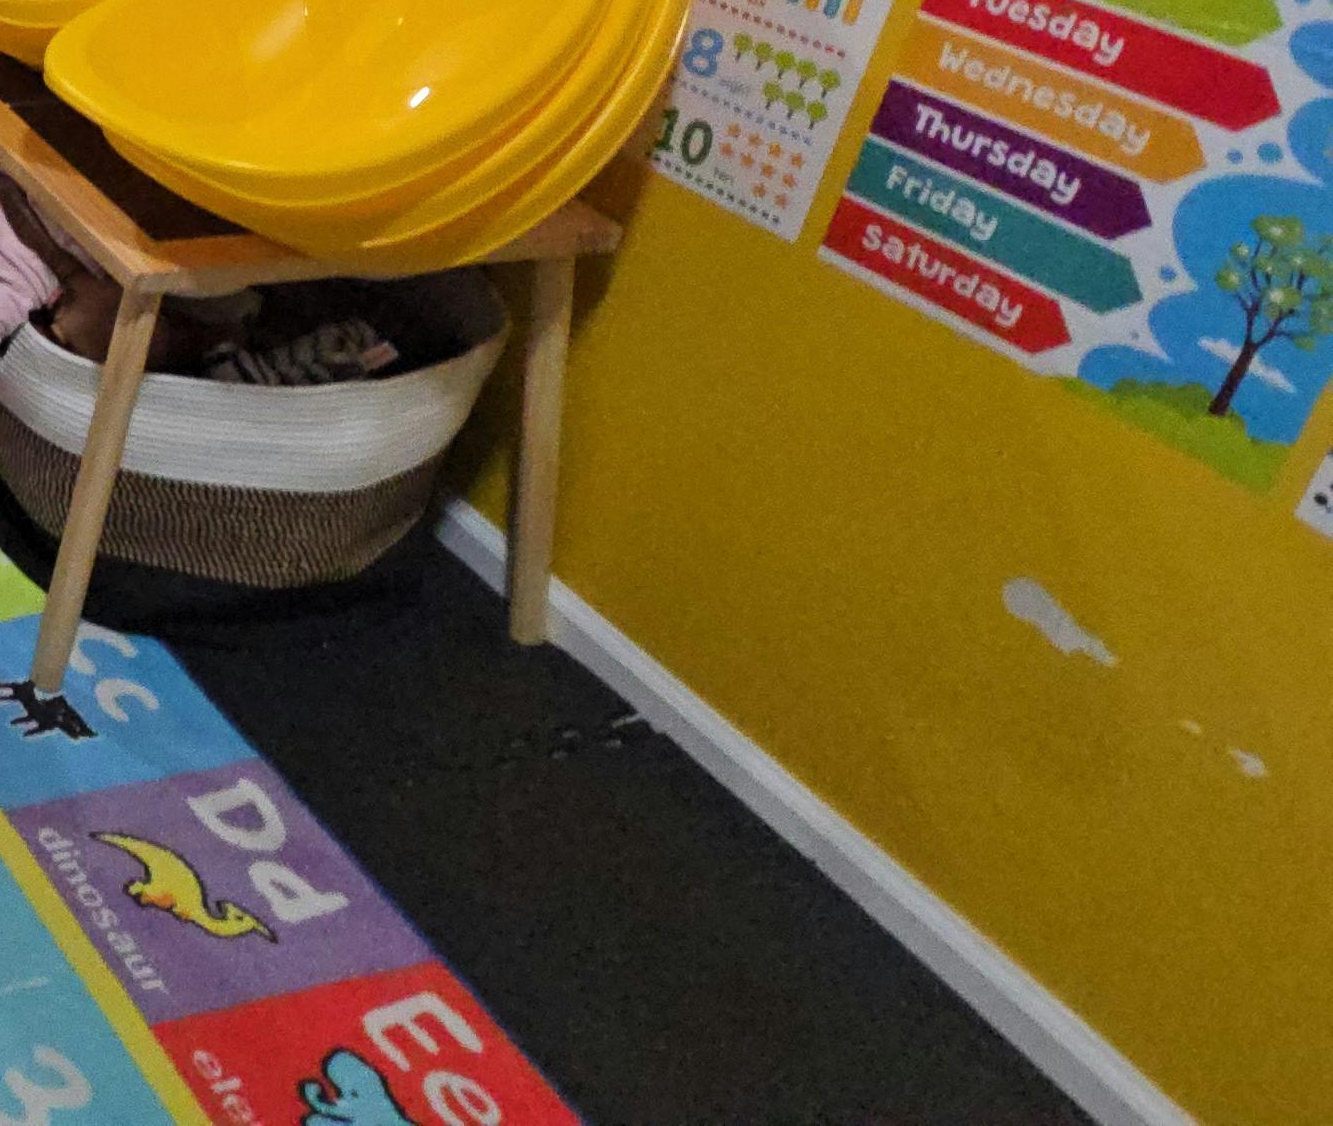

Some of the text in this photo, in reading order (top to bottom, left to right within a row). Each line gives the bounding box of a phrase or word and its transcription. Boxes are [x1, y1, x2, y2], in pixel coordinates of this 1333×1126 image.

[682, 27, 725, 78] 8
[937, 41, 1153, 156] Wednesday
[654, 106, 713, 167] 10
[913, 102, 1083, 206] Thursday
[885, 164, 1000, 243] Friday
[187, 778, 351, 925] Dd
[37, 824, 173, 996] dinosaur
[361, 990, 503, 1126] Ee
